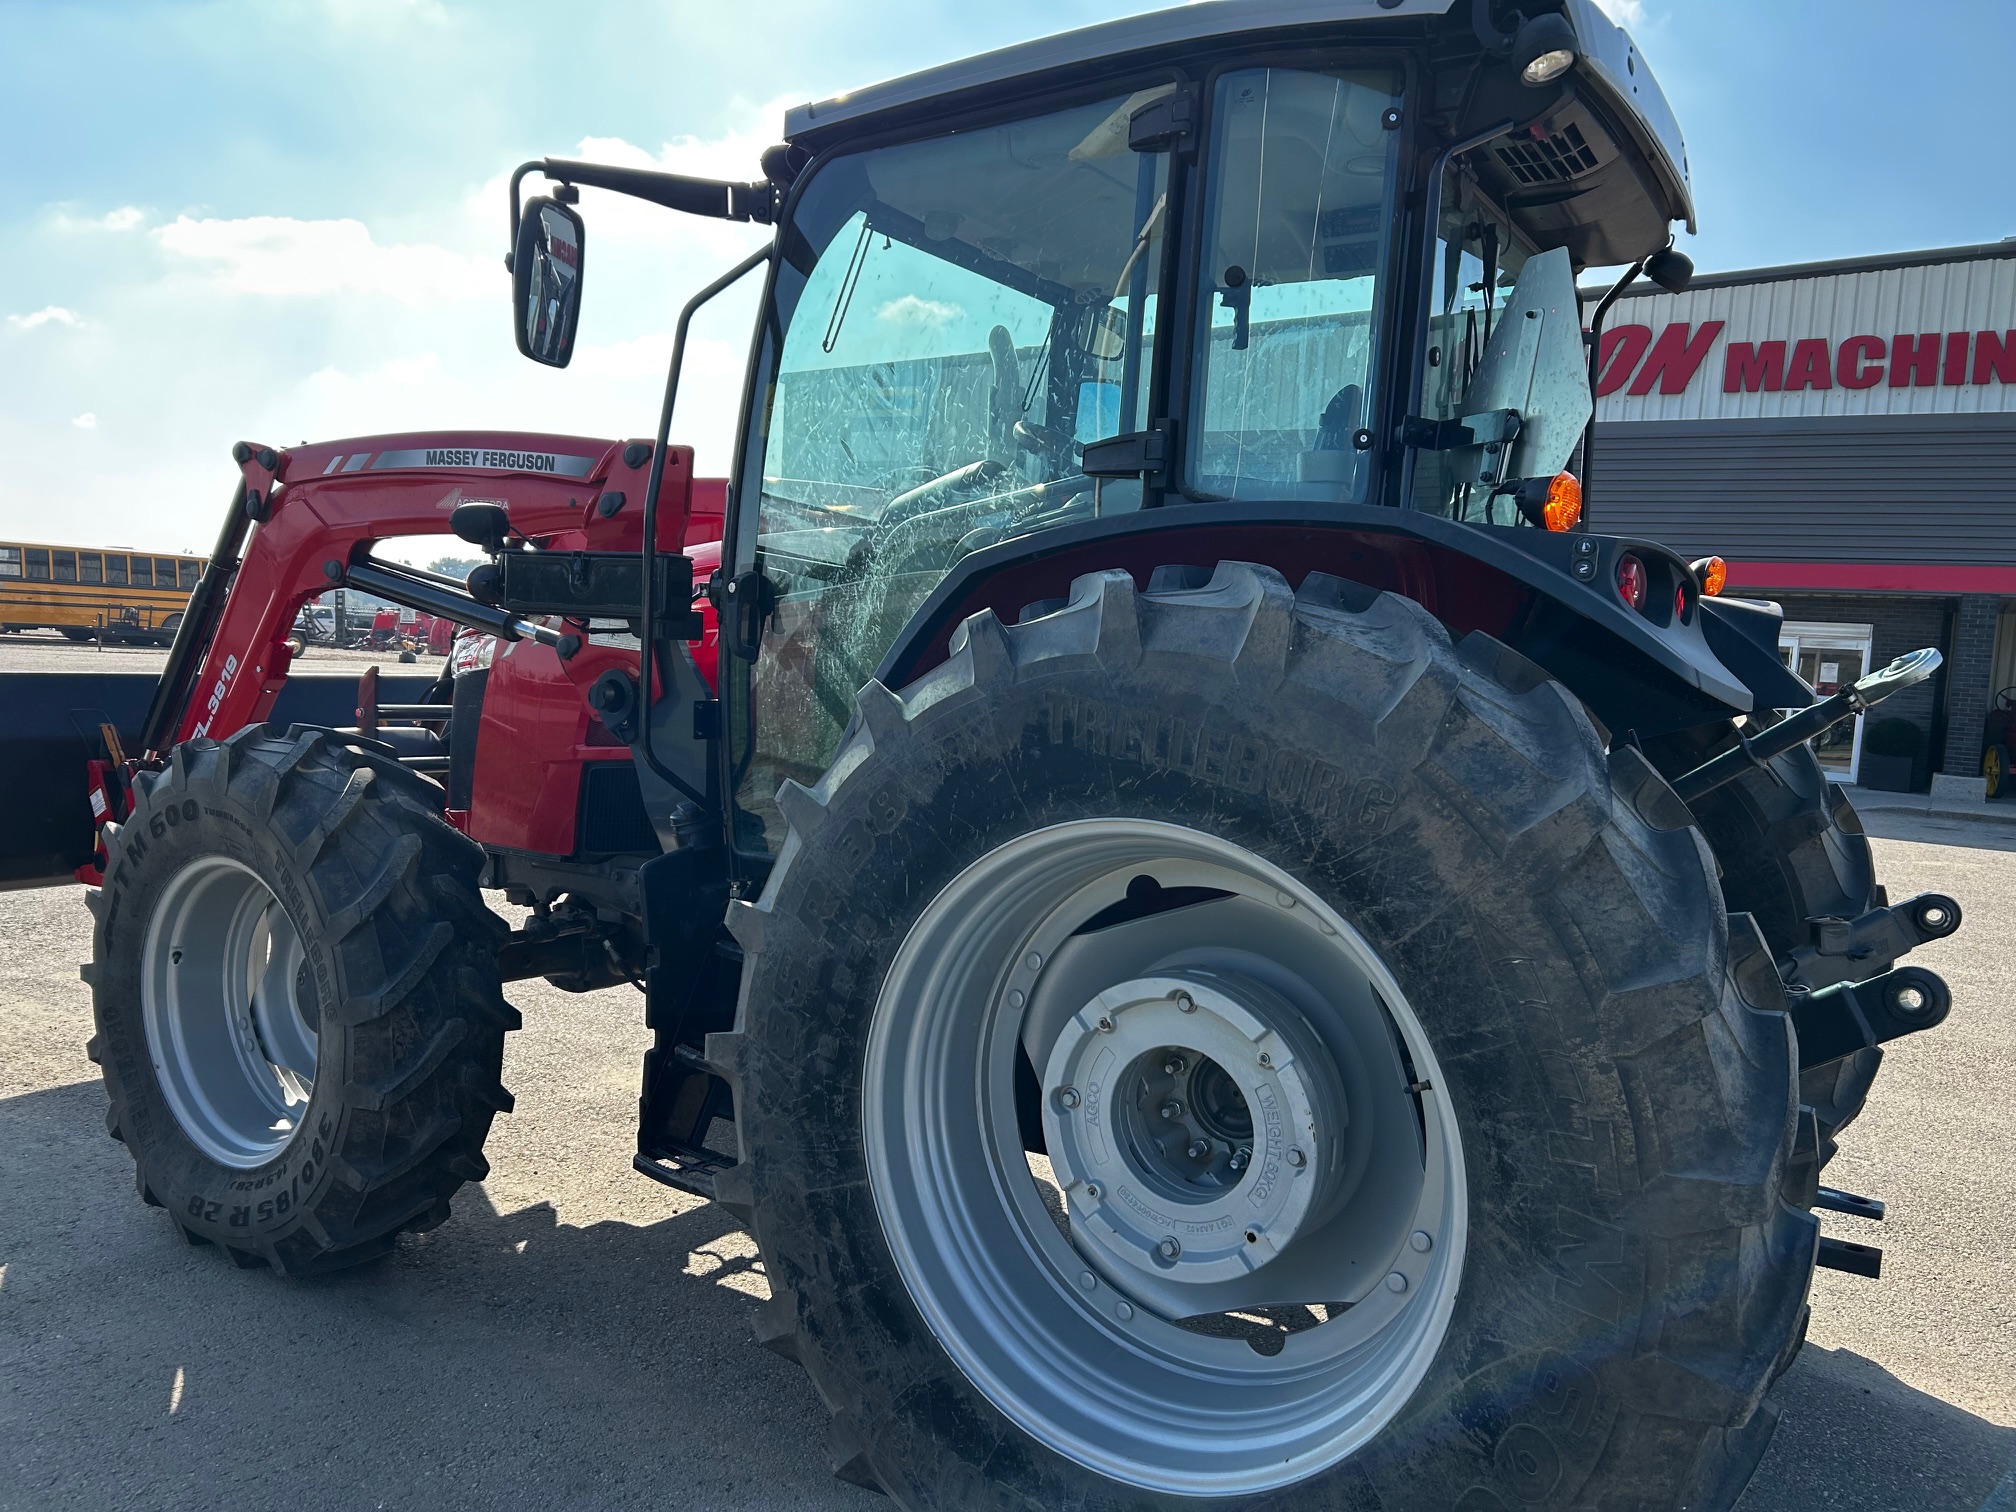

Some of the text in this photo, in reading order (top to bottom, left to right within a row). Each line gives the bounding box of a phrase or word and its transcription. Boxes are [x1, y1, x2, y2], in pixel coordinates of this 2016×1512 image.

[1582, 321, 2016, 397] ON MACHIN
[426, 451, 555, 472] MASSEY FERGUSON
[1043, 690, 1397, 834] TRELLEBORG
[113, 829, 148, 890] TM
[150, 798, 200, 840] 600
[828, 779, 909, 877] 38
[273, 849, 338, 1024] TRELLEBORG
[1086, 1081, 1101, 1127] AGCO
[1261, 1093, 1283, 1161] WEIGHT
[187, 1111, 333, 1228] 380/85 R 28
